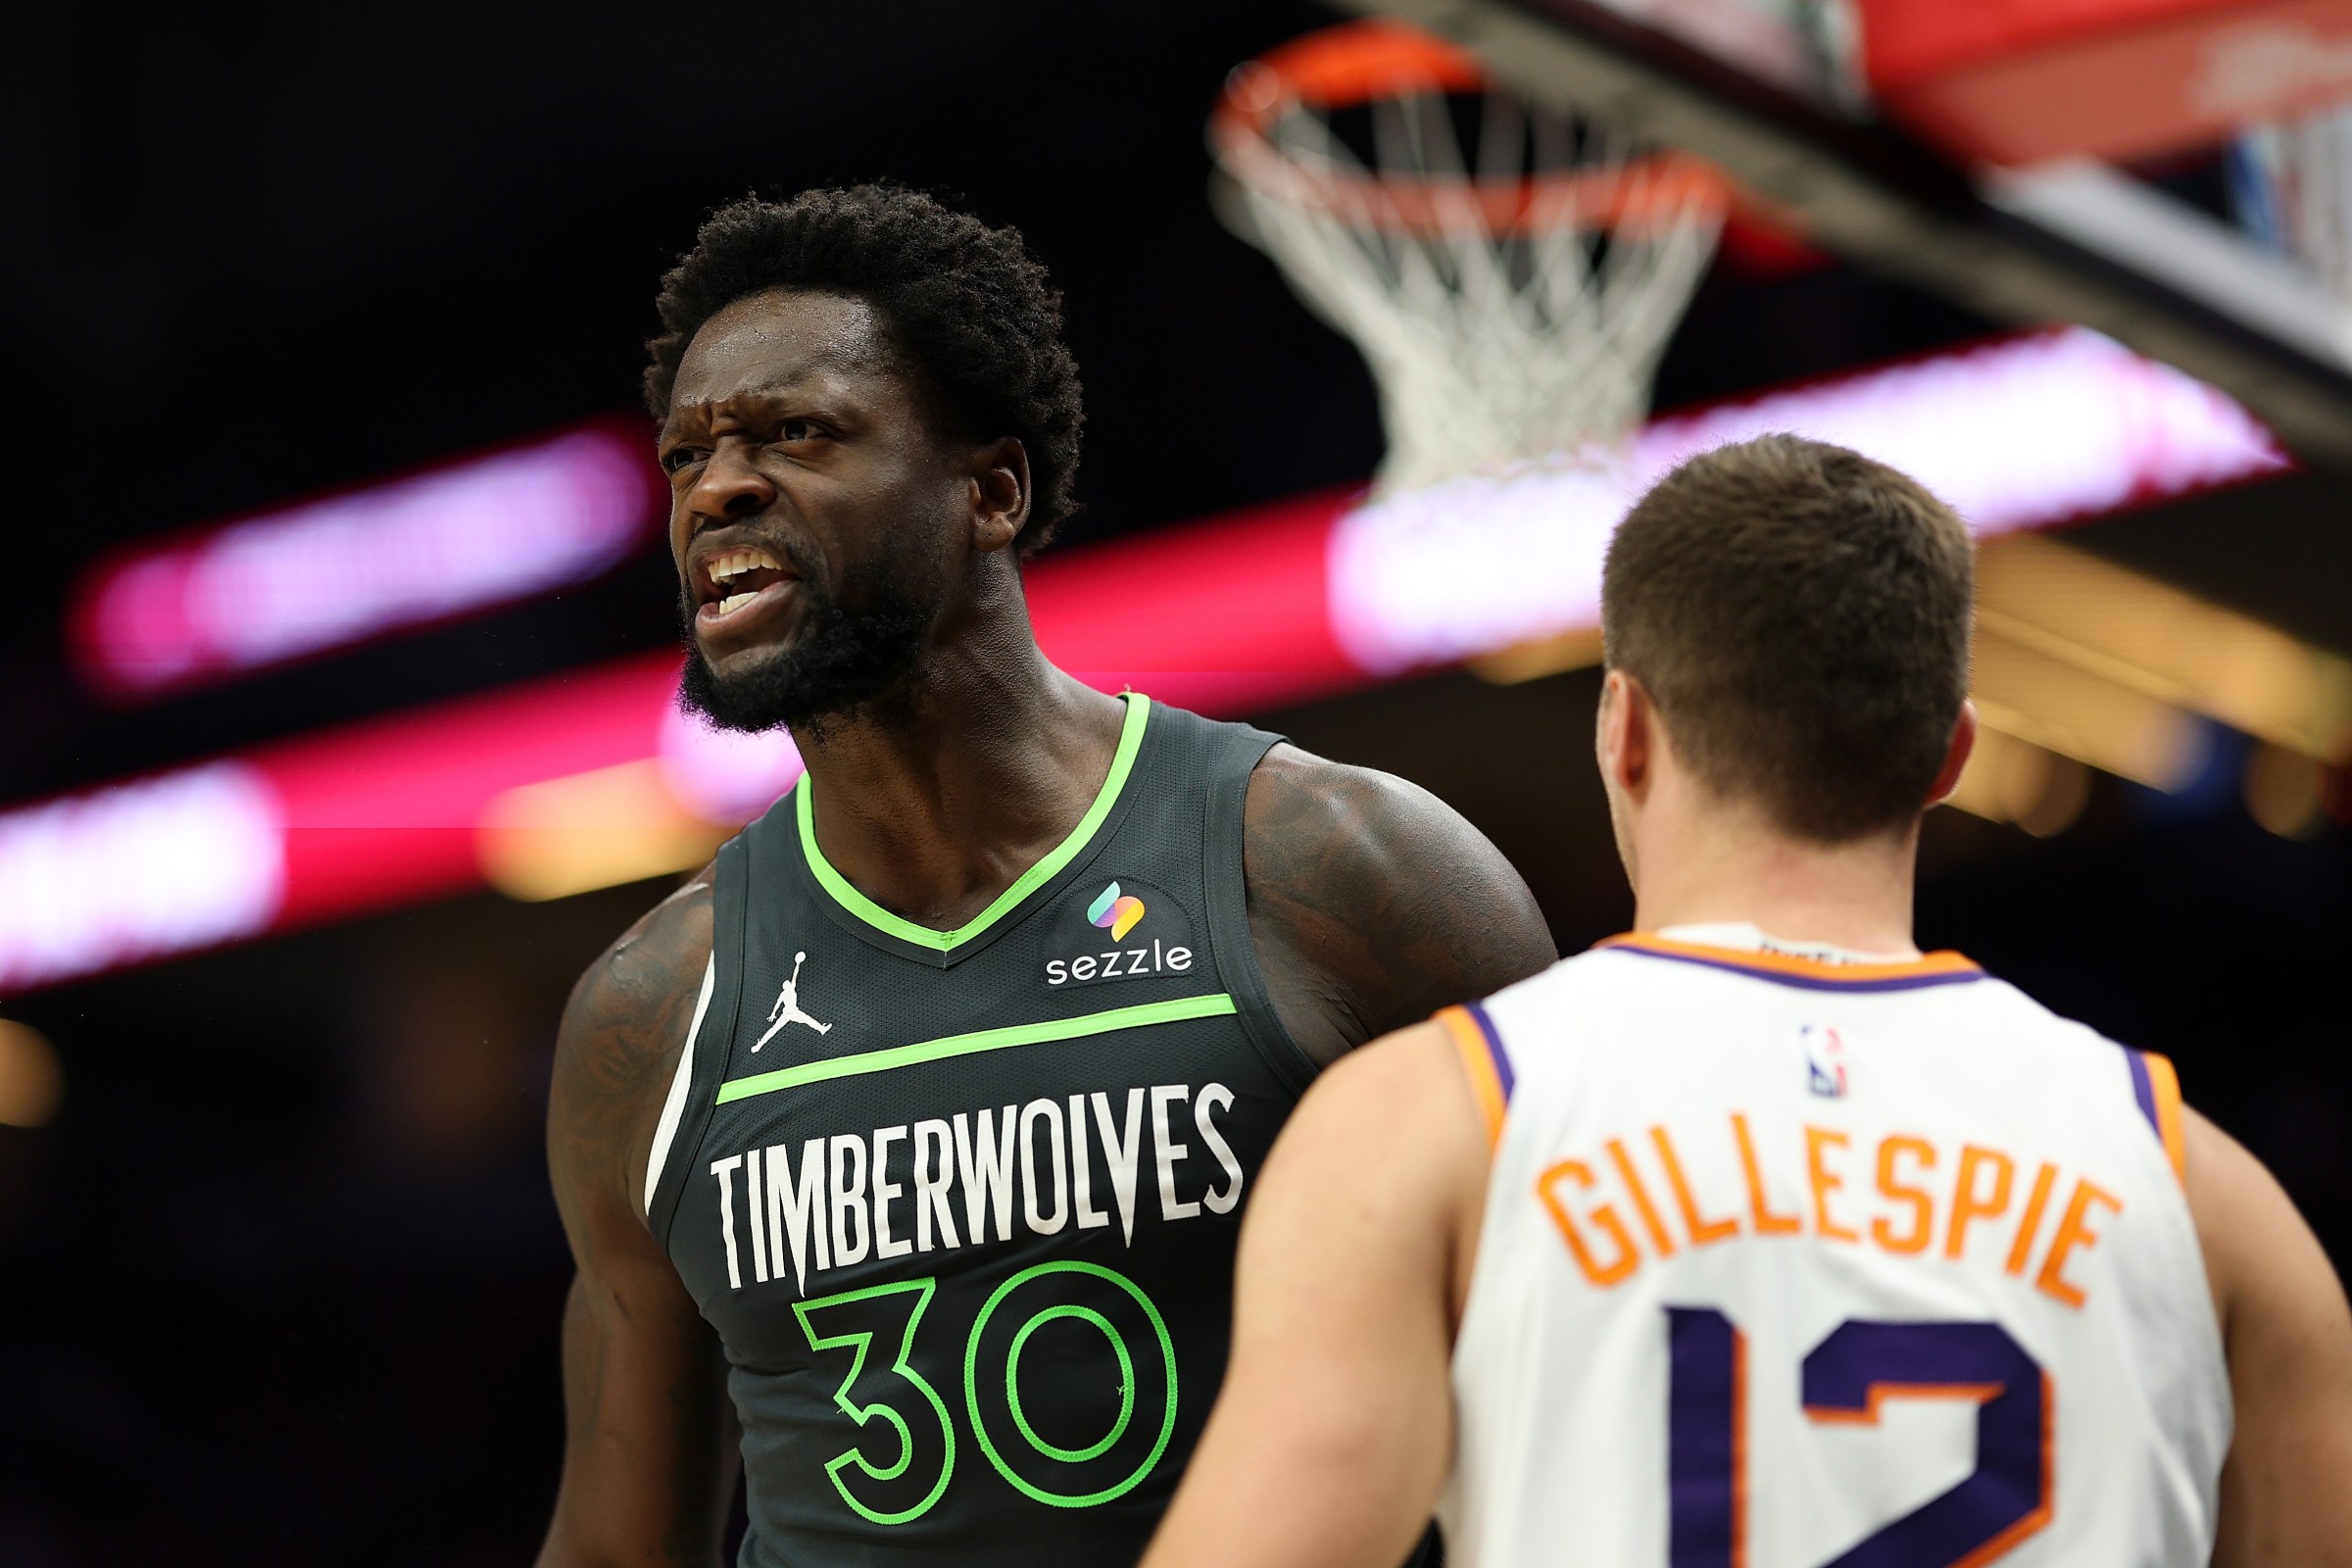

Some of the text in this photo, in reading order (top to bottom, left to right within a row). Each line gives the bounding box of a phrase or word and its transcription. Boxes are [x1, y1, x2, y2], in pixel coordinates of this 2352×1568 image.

[1046, 939, 1193, 985] sezzle
[710, 1082, 1244, 1298] TIMBERWOLVES
[1535, 1113, 2124, 1310] GILLESPIE
[792, 1260, 1178, 1525] 30
[1662, 1303, 2055, 1568] 12
